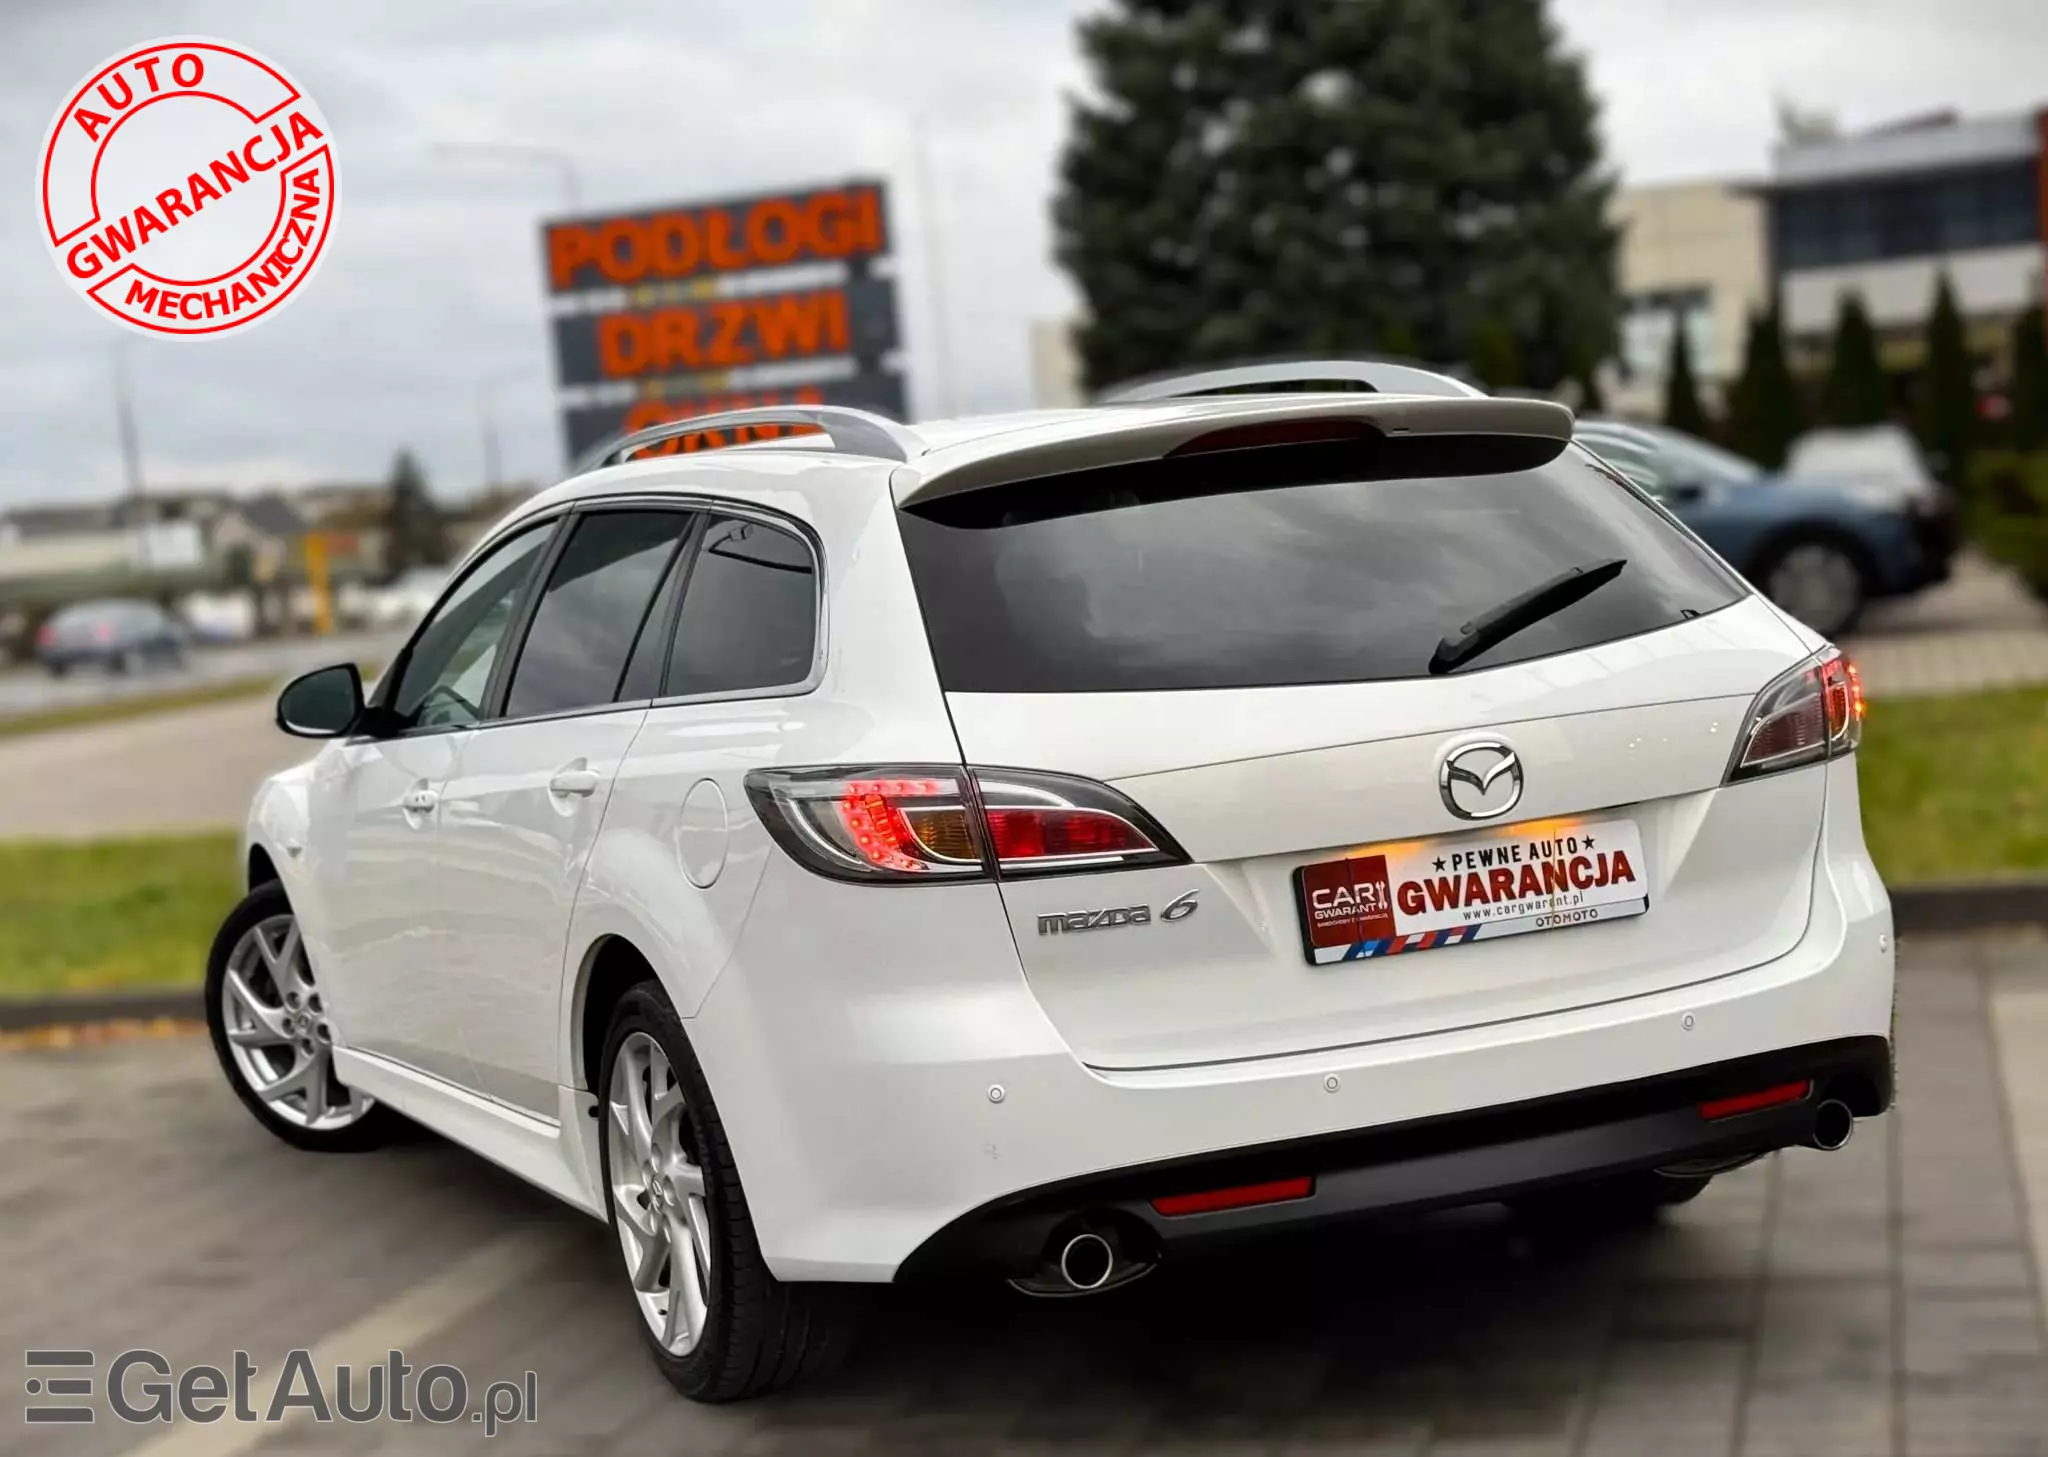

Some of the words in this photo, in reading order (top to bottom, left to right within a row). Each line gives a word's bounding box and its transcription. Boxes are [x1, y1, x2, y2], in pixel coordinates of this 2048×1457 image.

[599, 290, 848, 377] DRZWI
[1452, 843, 1521, 871] PEWNE
[1529, 836, 1579, 861] AUTO
[1312, 882, 1376, 909] CAR
[1397, 850, 1636, 916] GWARANCJA
[1160, 888, 1199, 923] 6
[1314, 902, 1377, 920] GWARANT
[1463, 891, 1584, 921] www.cargwarant.pl
[1535, 908, 1599, 928] OTOMOTO
